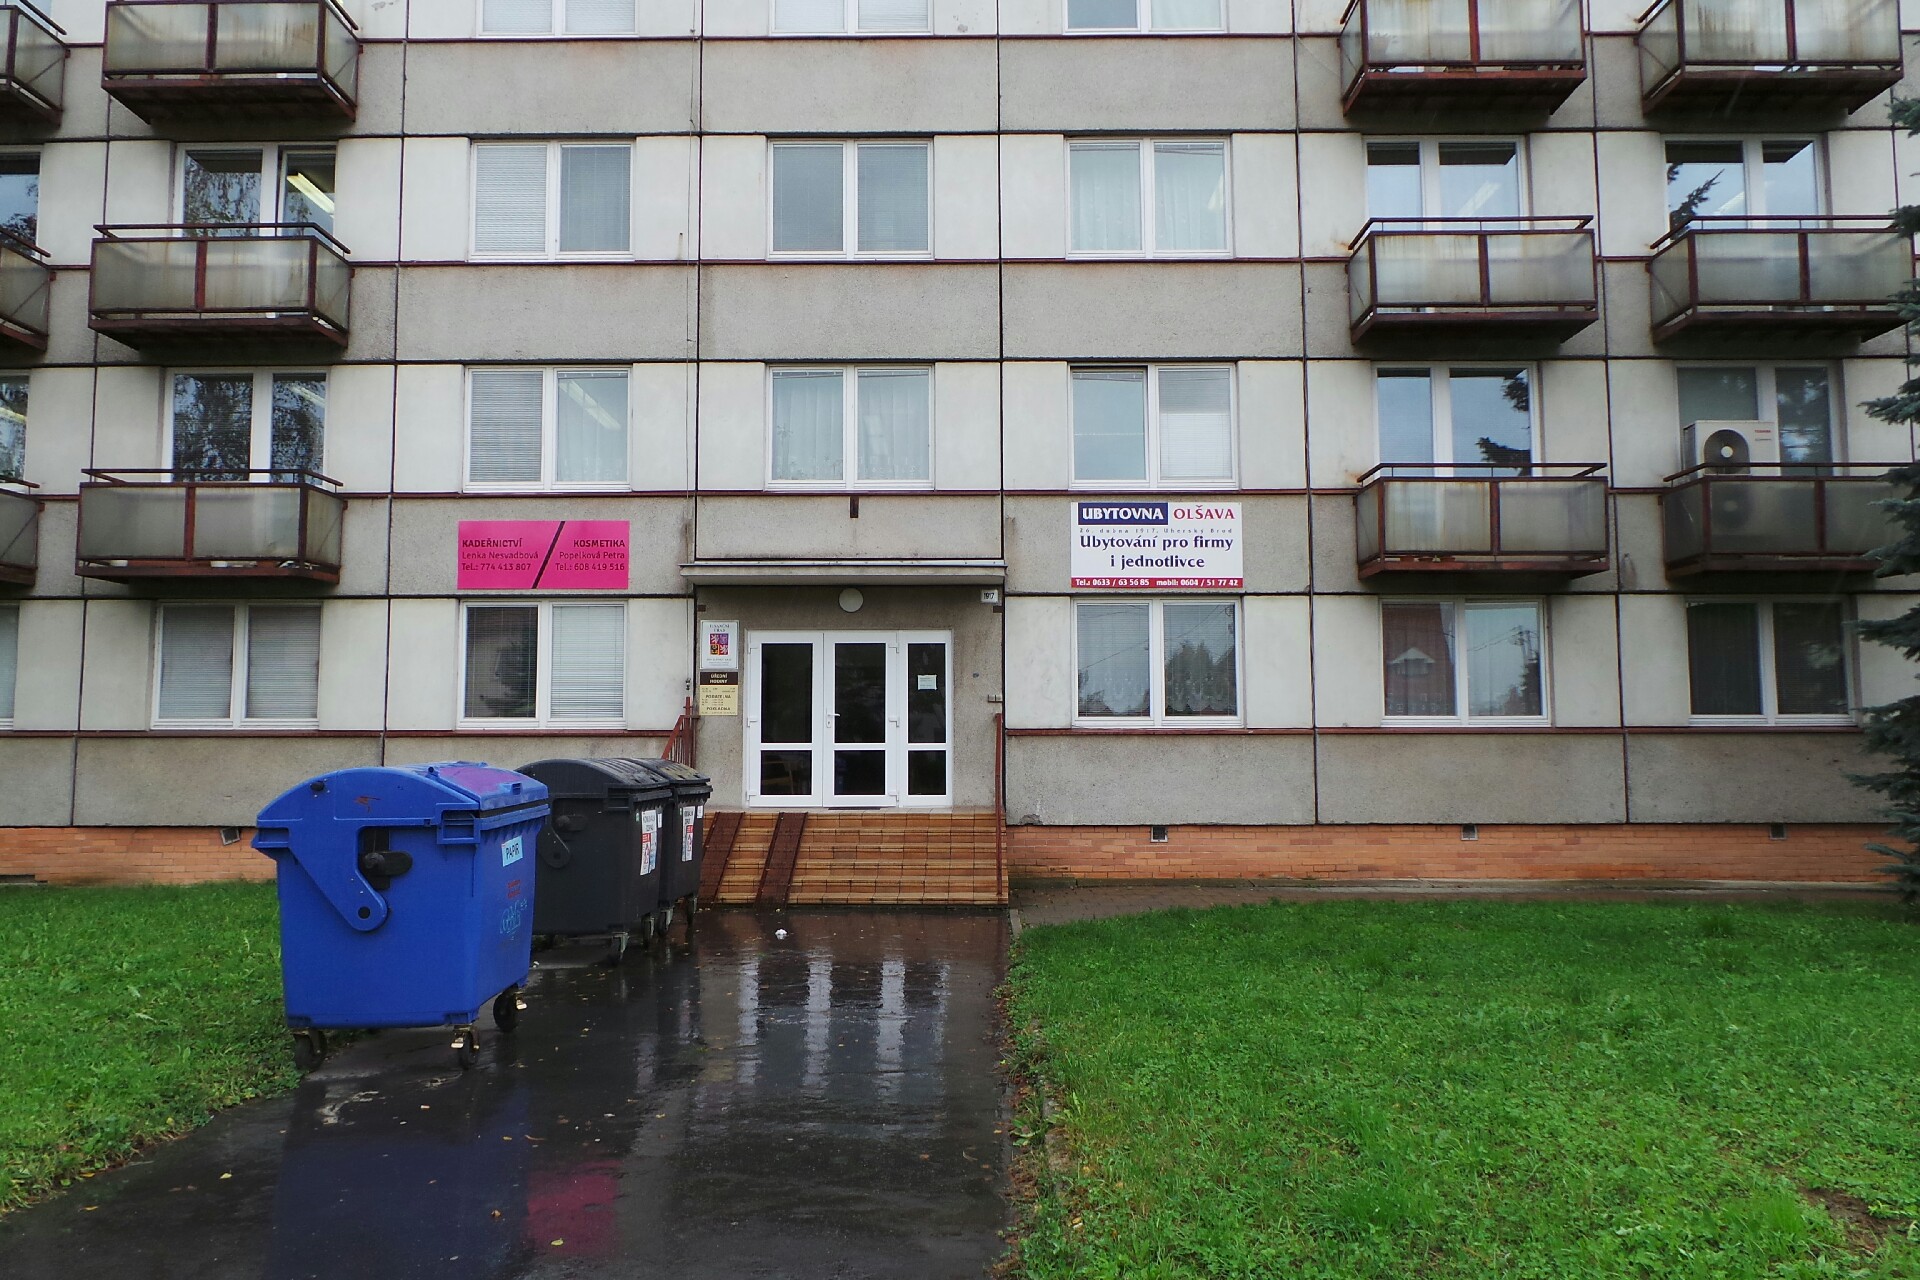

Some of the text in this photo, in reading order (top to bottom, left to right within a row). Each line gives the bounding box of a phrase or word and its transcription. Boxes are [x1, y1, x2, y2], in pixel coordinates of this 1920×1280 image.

[1082, 504, 1235, 520] UBYTOVNA OLŠAVA
[462, 538, 523, 548] KADEŘNICTVÍ
[573, 539, 625, 548] KOSMETIKA
[1080, 535, 1234, 551] Ubytování pro firmy
[462, 551, 539, 559] Lenka Nesvadbová
[560, 551, 625, 561] Popelková Petra
[480, 563, 496, 571] 774
[498, 563, 514, 571] 413
[515, 563, 532, 571] 807
[555, 563, 625, 571] Tel.: 608 419 516
[1110, 555, 1205, 571] i jednotlivce
